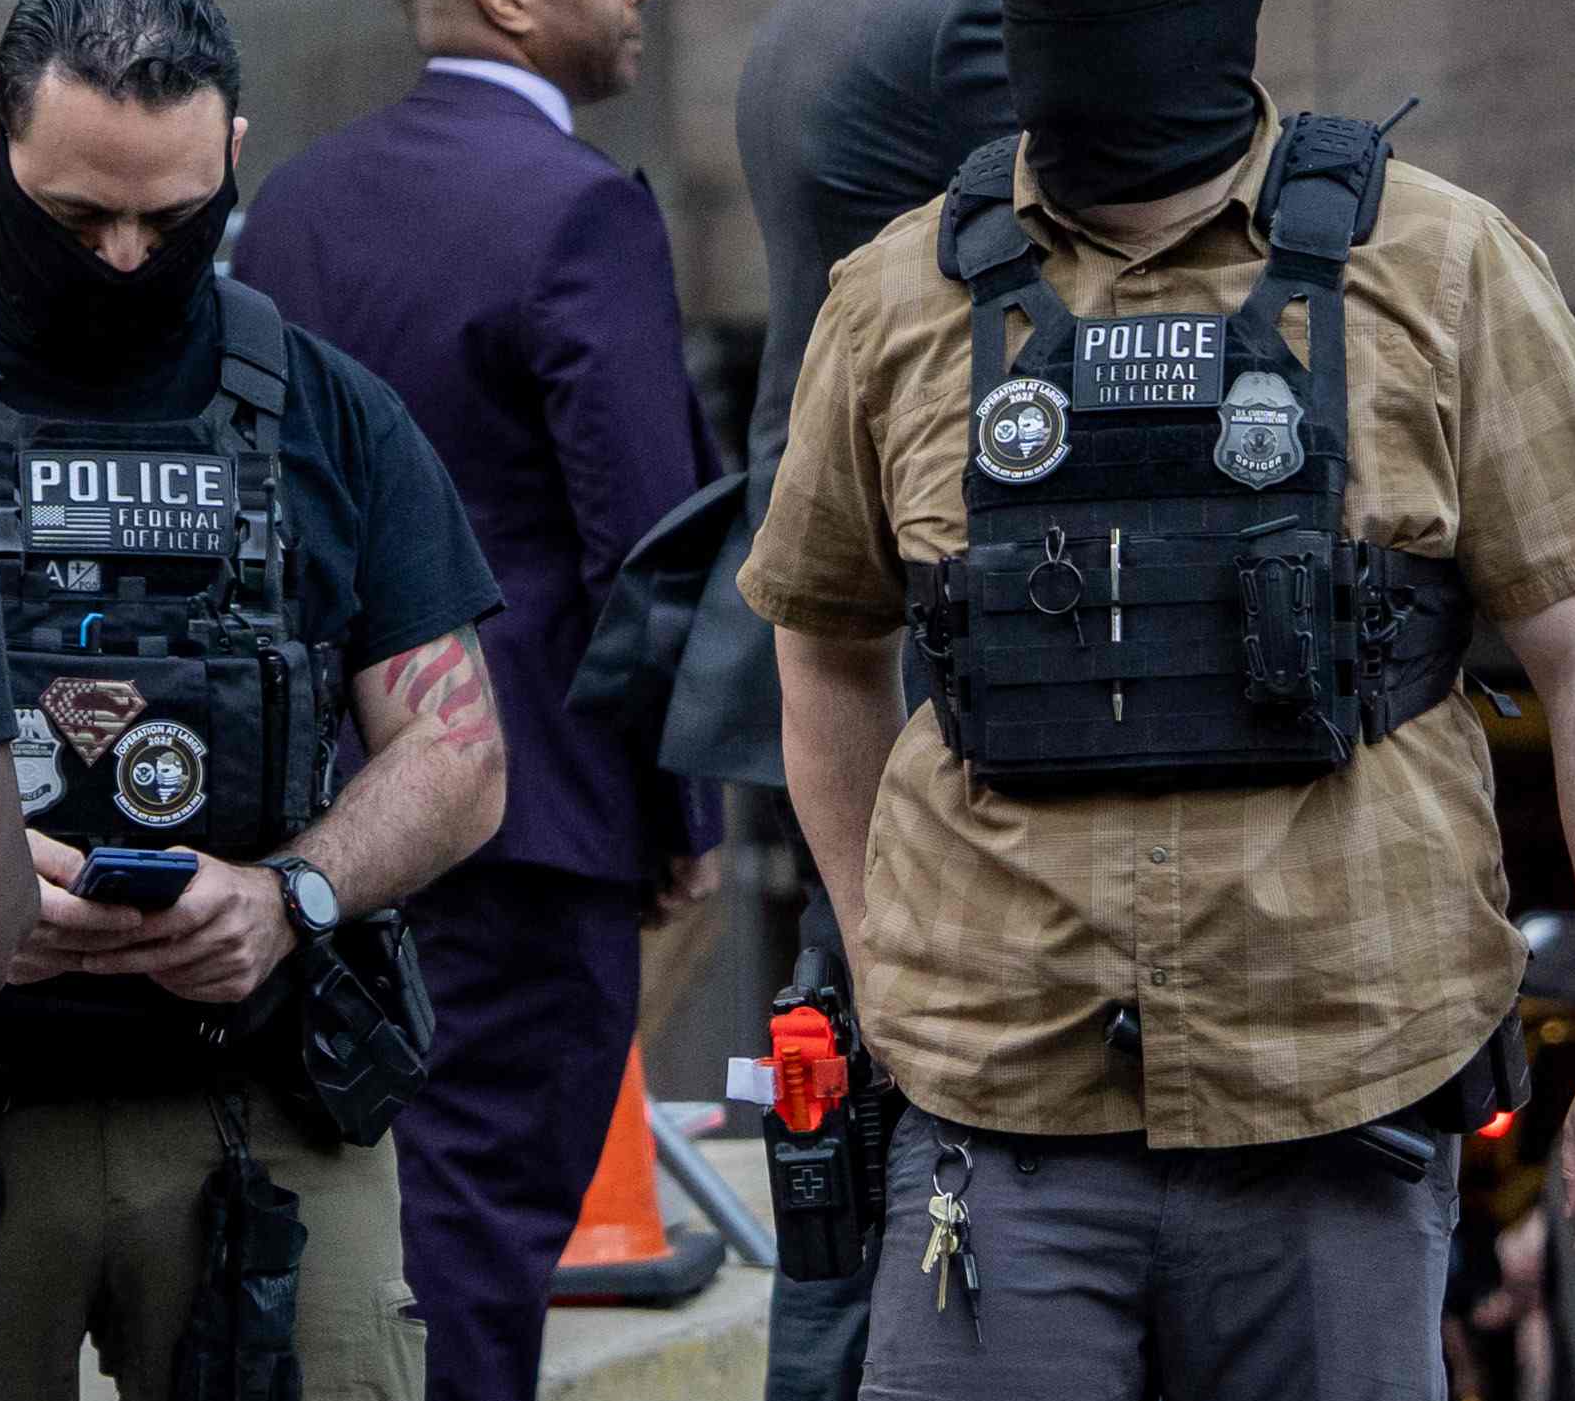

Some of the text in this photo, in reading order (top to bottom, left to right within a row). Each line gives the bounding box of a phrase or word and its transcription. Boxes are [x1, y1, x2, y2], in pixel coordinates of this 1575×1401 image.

[1084, 321, 1217, 361] POLICE
[1095, 363, 1199, 382] FEDERAL
[980, 382, 1065, 414] OPERATION AT LARGE
[1009, 392, 1035, 403] 2025
[1099, 384, 1196, 403] OFFICER
[1235, 454, 1282, 471] OFFICER
[30, 460, 225, 507] POLICE
[118, 508, 223, 530] FEDERAL
[122, 528, 220, 551] OFFICER
[119, 725, 202, 754] OPERATION AT LARGE
